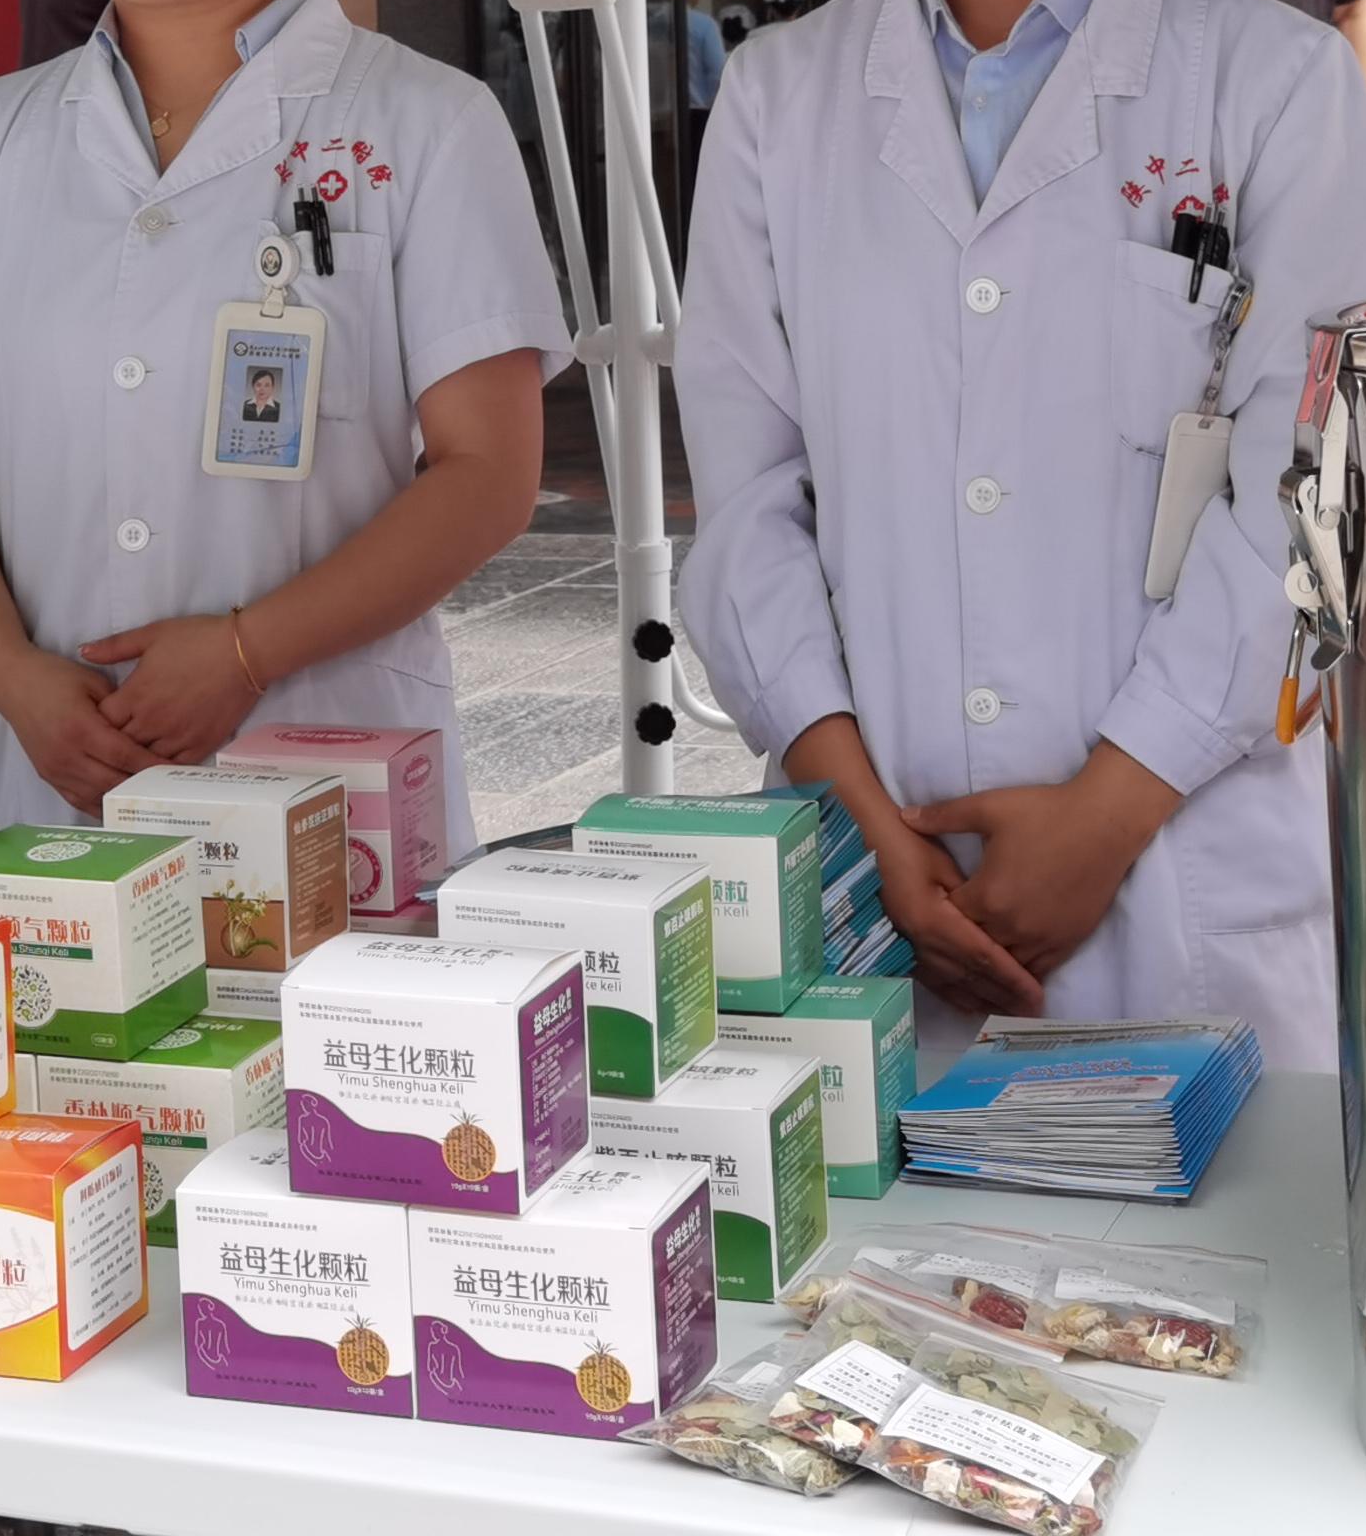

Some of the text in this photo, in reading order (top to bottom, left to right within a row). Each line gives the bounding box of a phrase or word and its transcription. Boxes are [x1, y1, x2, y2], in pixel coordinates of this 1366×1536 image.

[198, 840, 240, 861] 颗粒
[323, 1039, 476, 1079] 益母生化颗粒
[338, 1074, 464, 1095] Yimu Shenghua Keli
[220, 1242, 370, 1283] 益母生化颗粒
[234, 1276, 358, 1299] Yimu Shenghua Keli
[453, 1264, 611, 1307] 益母生化颗粒
[467, 1299, 598, 1323] Yimu Shenghua Keli
